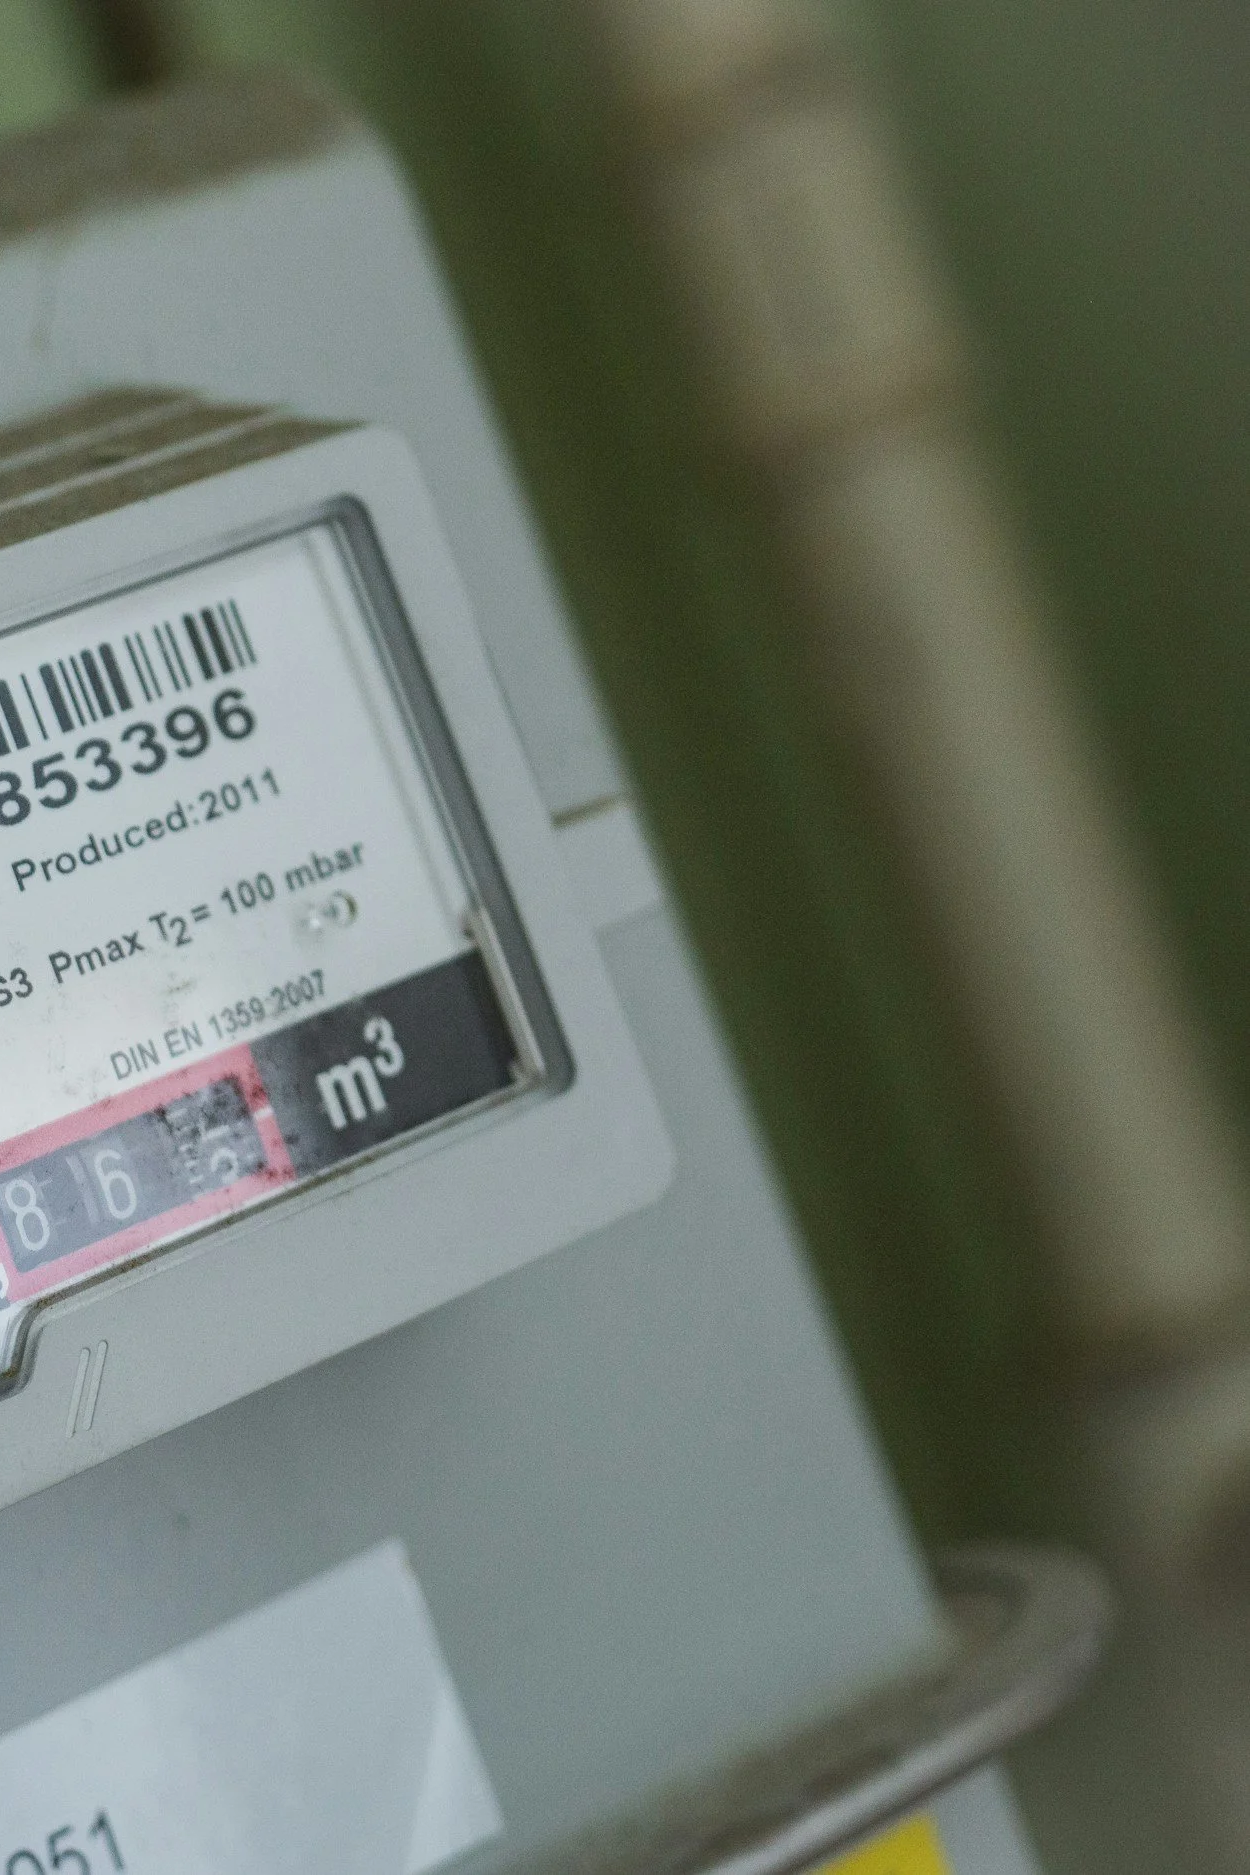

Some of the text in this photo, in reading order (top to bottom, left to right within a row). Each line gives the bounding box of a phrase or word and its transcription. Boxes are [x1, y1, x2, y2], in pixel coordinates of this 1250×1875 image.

[11, 768, 281, 891] Produced:2011
[49, 930, 144, 984] Pmax
[220, 871, 276, 915] 100
[285, 841, 364, 893] mbar
[110, 1039, 161, 1080] DIN
[163, 1022, 204, 1058] EN
